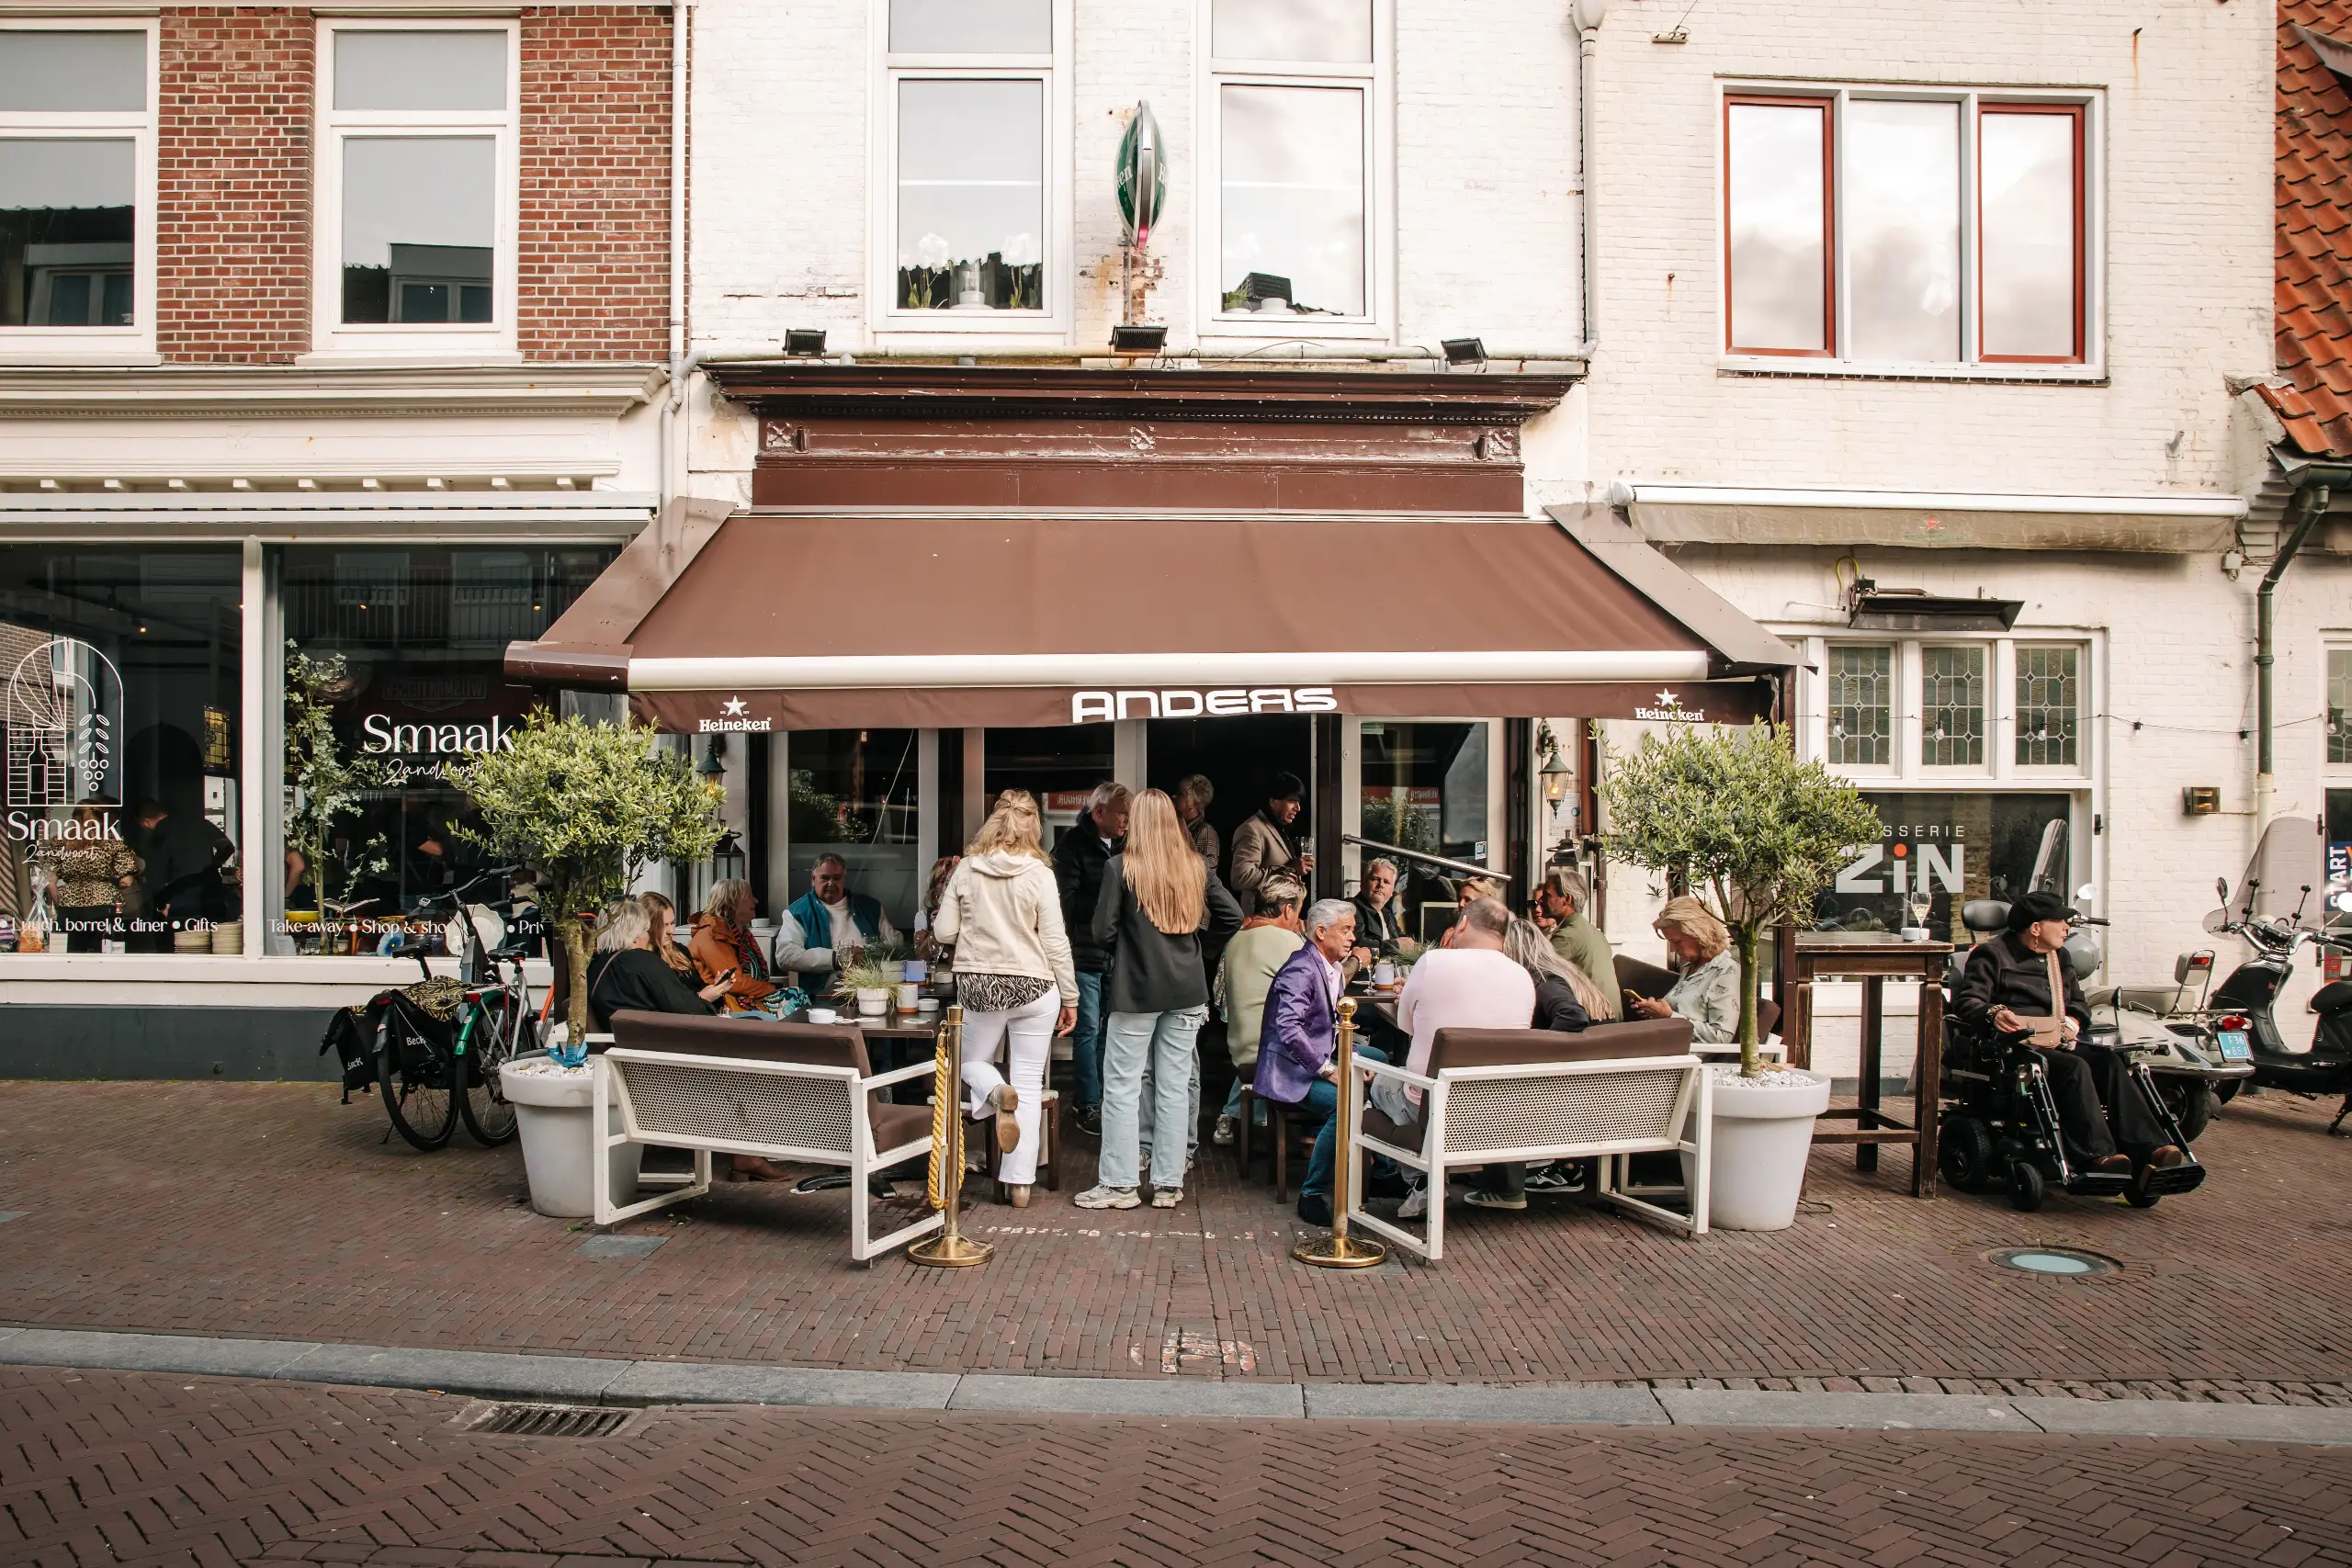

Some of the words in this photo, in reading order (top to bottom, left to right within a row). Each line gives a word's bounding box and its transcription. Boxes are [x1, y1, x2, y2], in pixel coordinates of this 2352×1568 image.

[1634, 707, 1705, 722] Heineken
[699, 717, 772, 732] Heineken
[364, 714, 516, 754] Smaak
[7, 811, 123, 841] Smaak
[1877, 825, 1964, 837] SSERIE
[65, 918, 109, 931] borrel
[112, 917, 127, 932] &
[130, 918, 167, 932] diner
[185, 917, 219, 932] Gifts
[267, 919, 345, 936] Take-away
[362, 919, 400, 938] Shop
[403, 920, 417, 934] &
